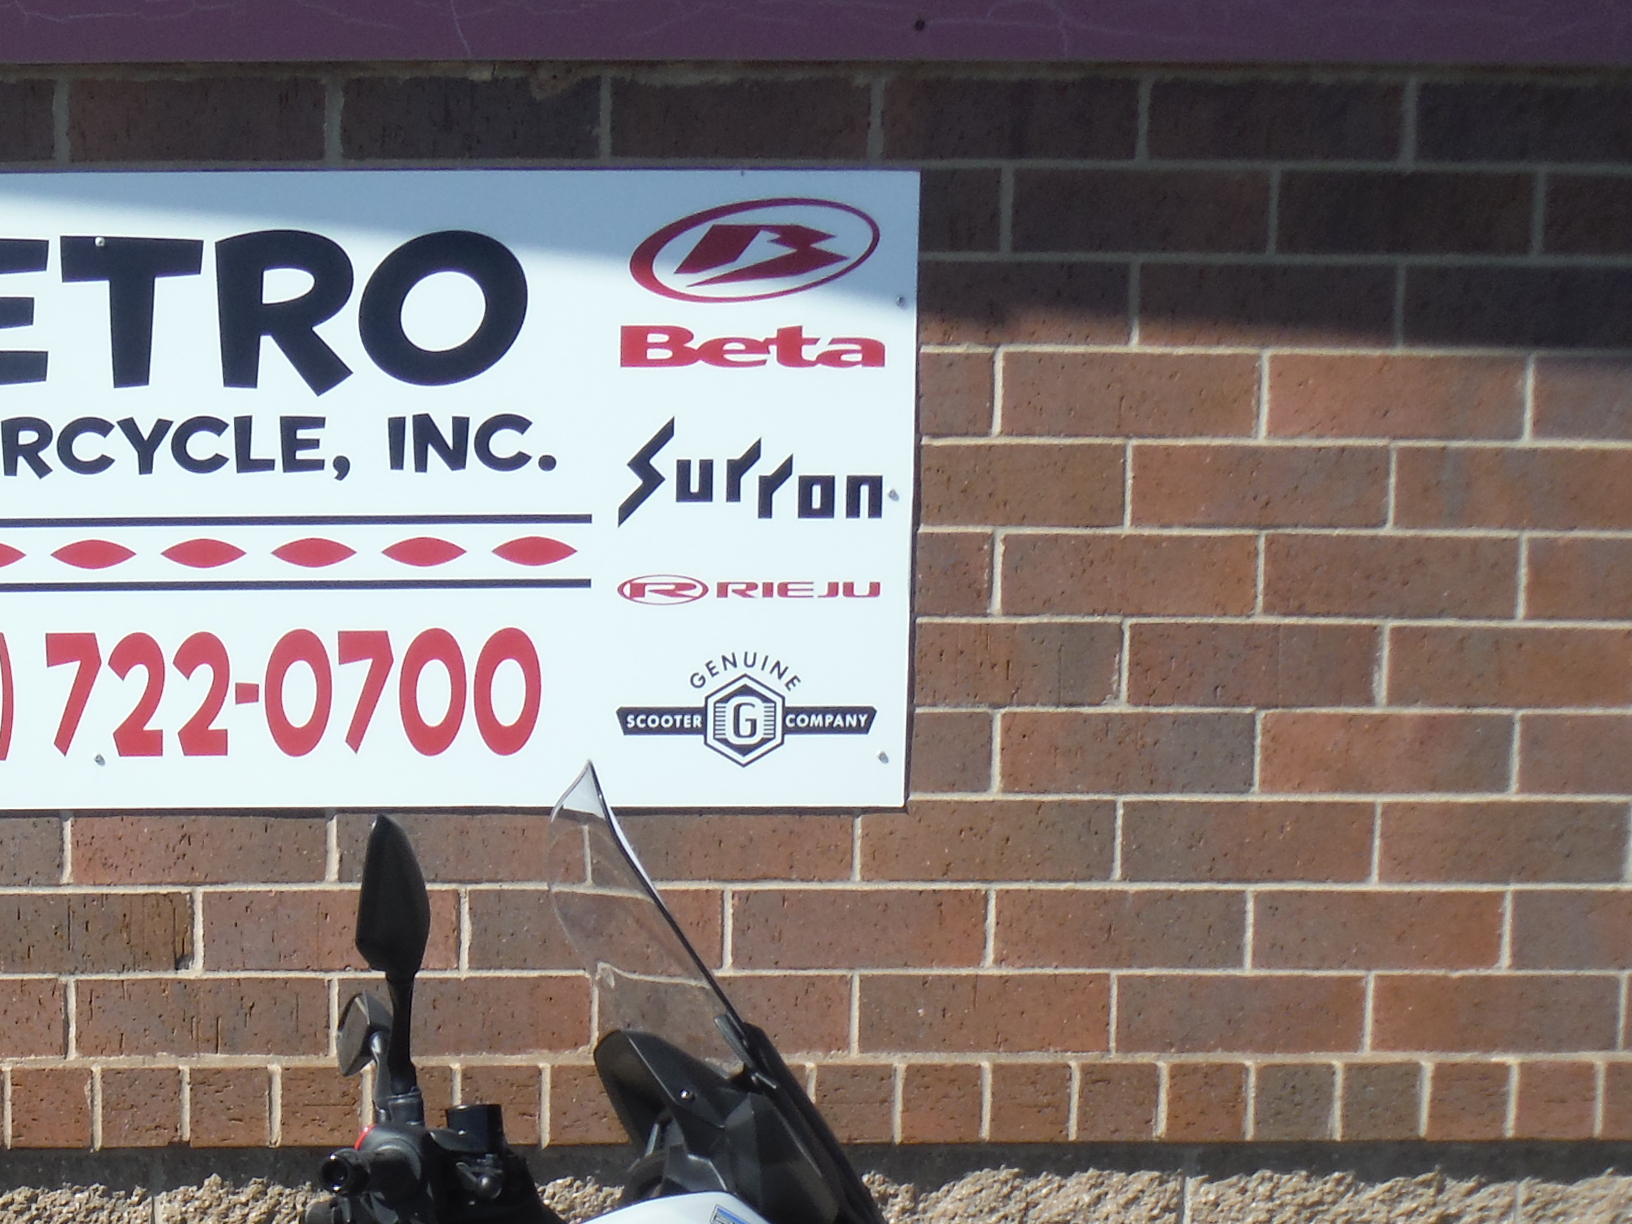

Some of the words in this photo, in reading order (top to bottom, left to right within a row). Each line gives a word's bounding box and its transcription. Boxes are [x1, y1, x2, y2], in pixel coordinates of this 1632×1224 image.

[620, 325, 886, 368] Beta
[387, 413, 557, 473] INC.
[617, 416, 883, 528] Surron
[716, 581, 881, 598] RIEJU
[689, 651, 801, 691] GENUINE
[45, 627, 542, 757] 722-0700
[626, 713, 703, 729] SCOOTER
[784, 713, 869, 728] COMPANY
[732, 702, 758, 739] G
